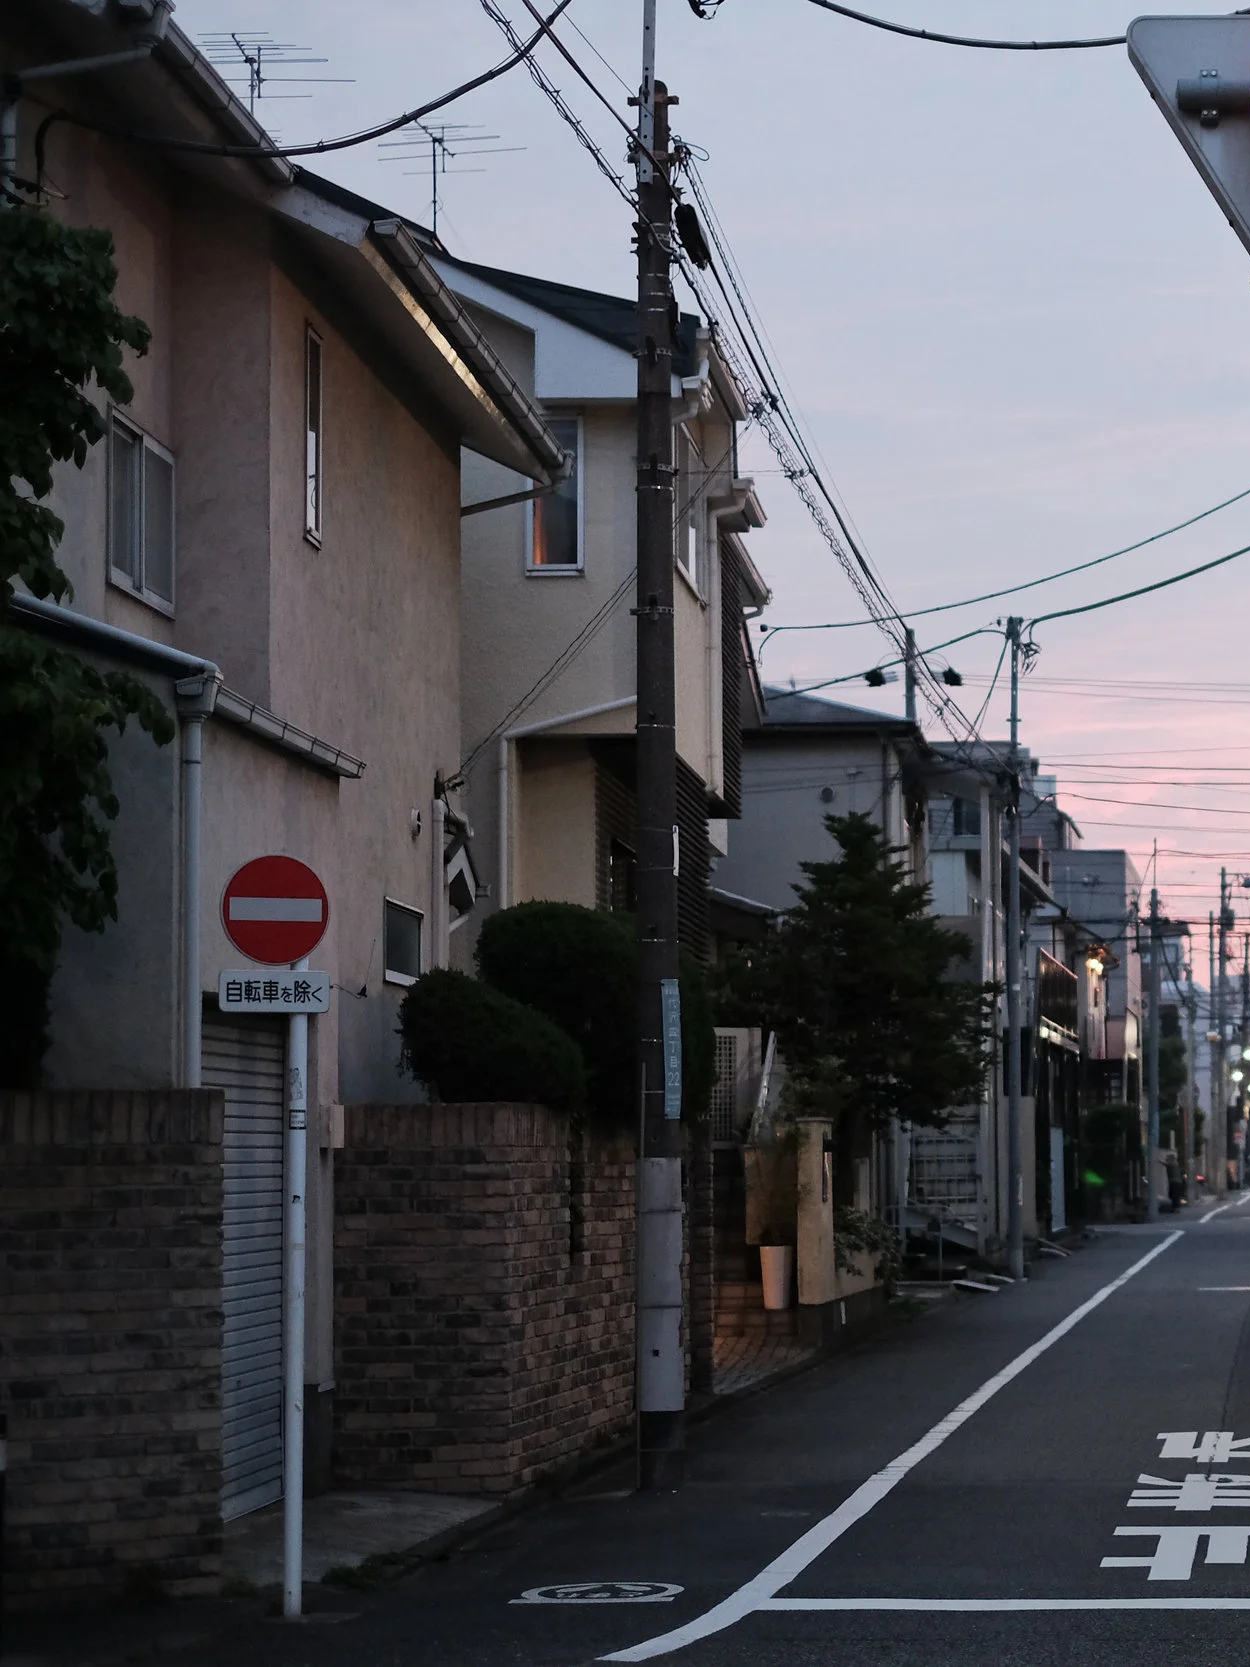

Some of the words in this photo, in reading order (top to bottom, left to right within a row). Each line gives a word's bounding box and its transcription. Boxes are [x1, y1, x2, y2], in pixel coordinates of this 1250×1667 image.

[226, 979, 322, 1003] 自転車を除く
